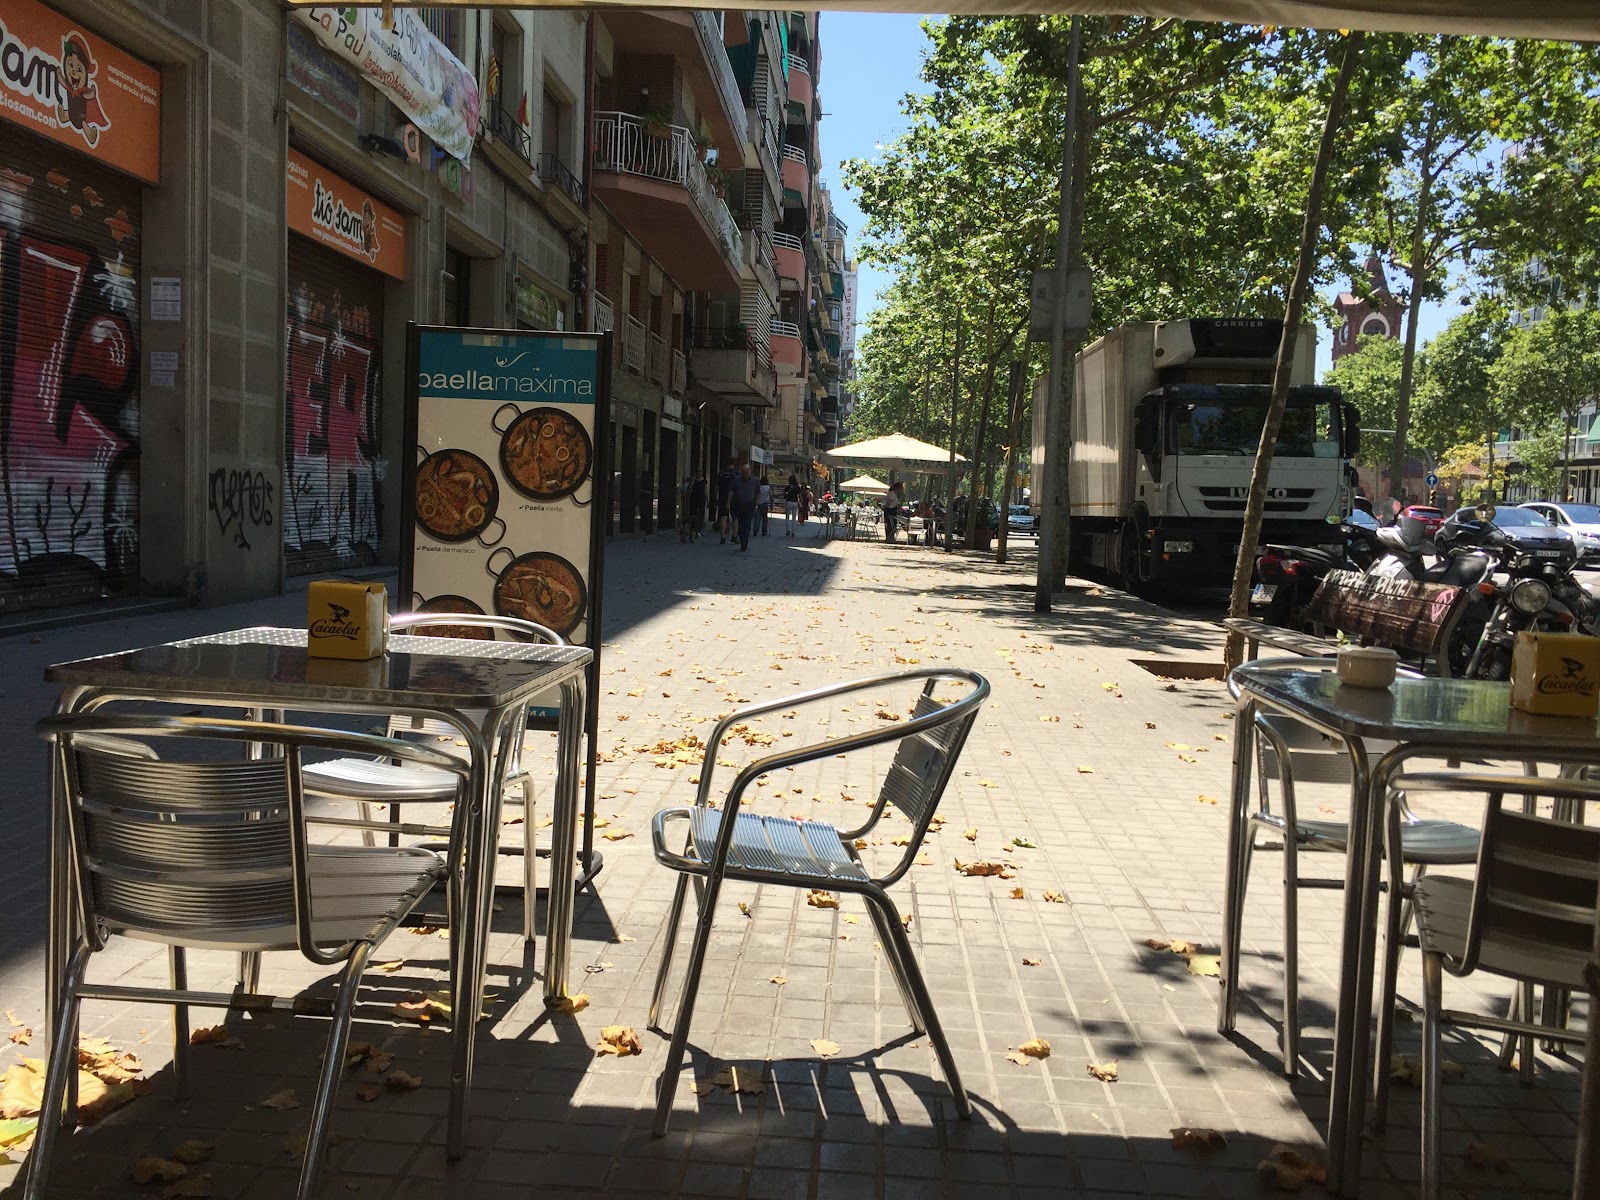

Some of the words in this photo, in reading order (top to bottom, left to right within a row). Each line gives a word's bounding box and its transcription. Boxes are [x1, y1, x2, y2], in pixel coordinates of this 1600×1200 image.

[335, 17, 366, 57] Pau
[0, 27, 63, 105] am
[1214, 320, 1263, 328] CARRIER
[1228, 487, 1289, 500] IVCO
[309, 619, 361, 641] Cacaolat
[1538, 673, 1596, 697] Cacaolat
